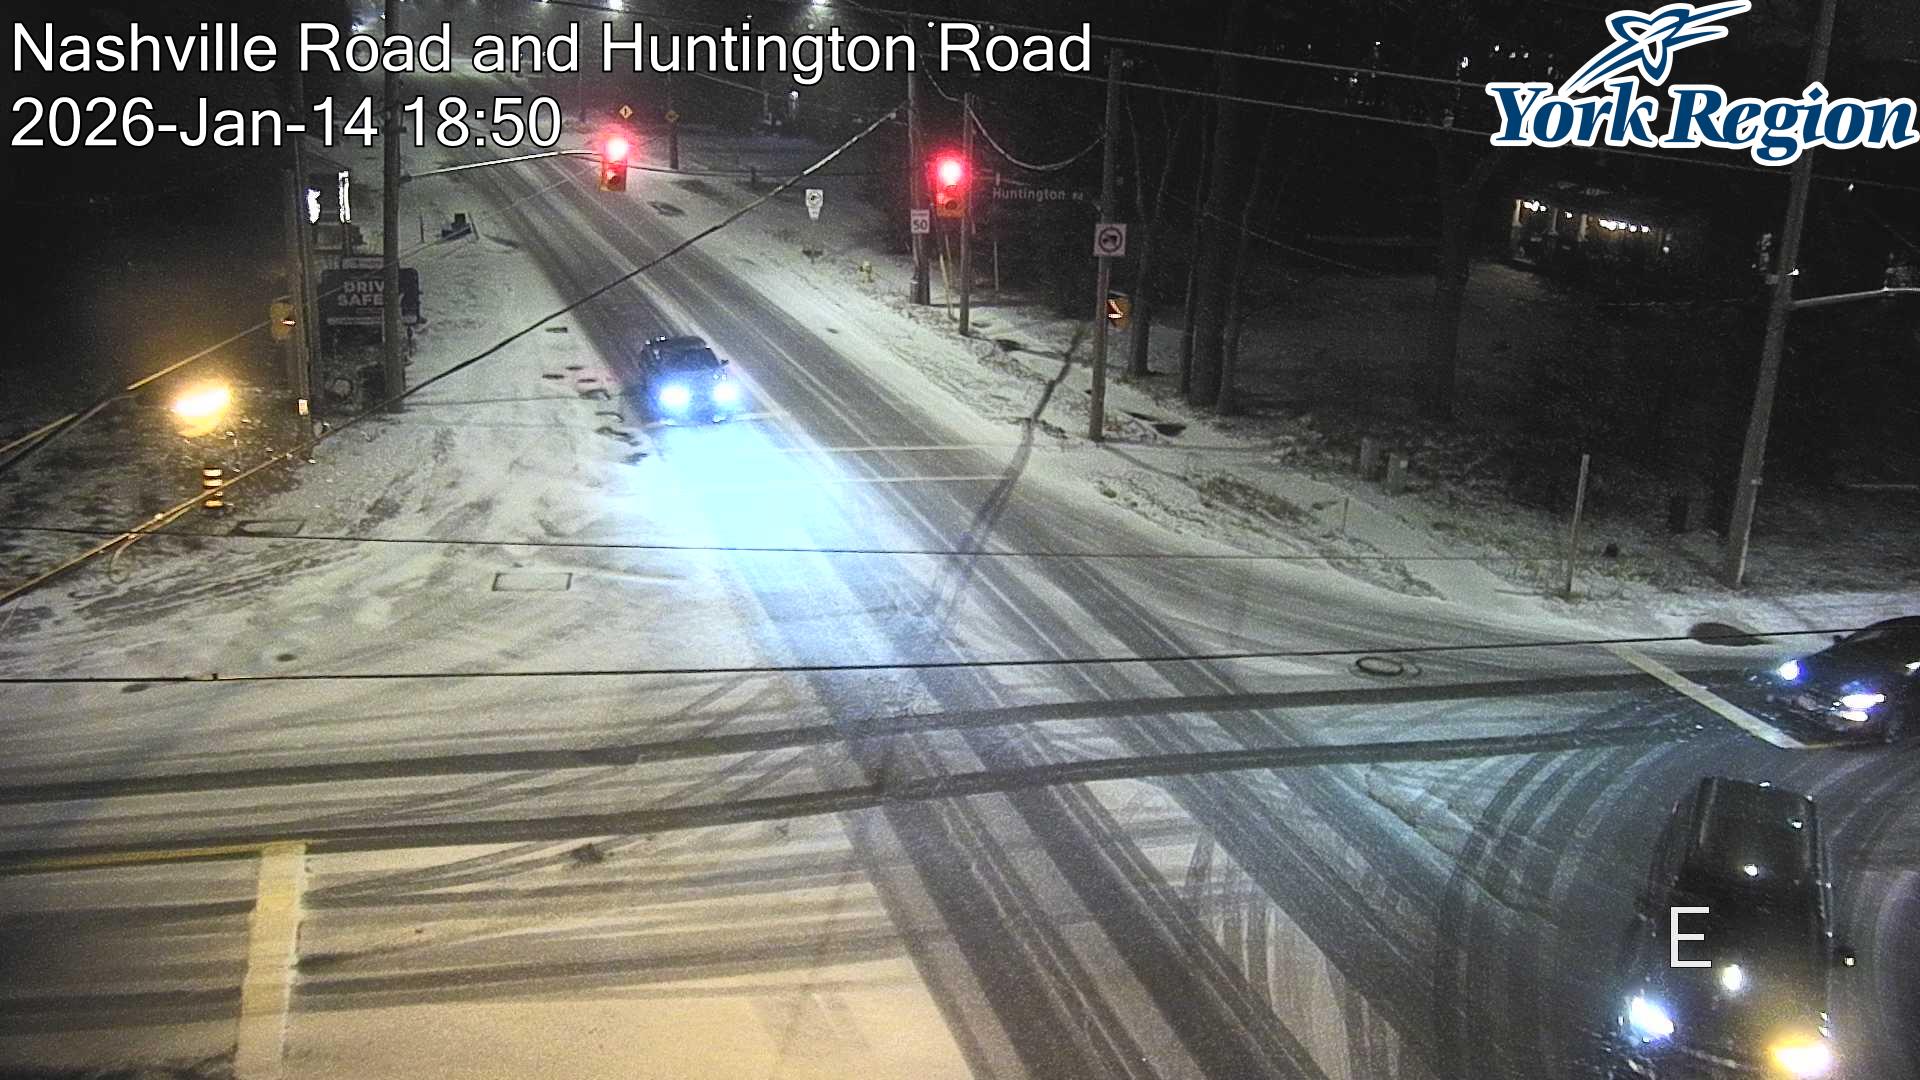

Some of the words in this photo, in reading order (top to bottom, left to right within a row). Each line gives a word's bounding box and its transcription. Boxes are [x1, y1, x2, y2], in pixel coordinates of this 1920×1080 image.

[992, 187, 1066, 202] Huntington
[913, 219, 928, 231] 50
[344, 280, 385, 293] DRIV
